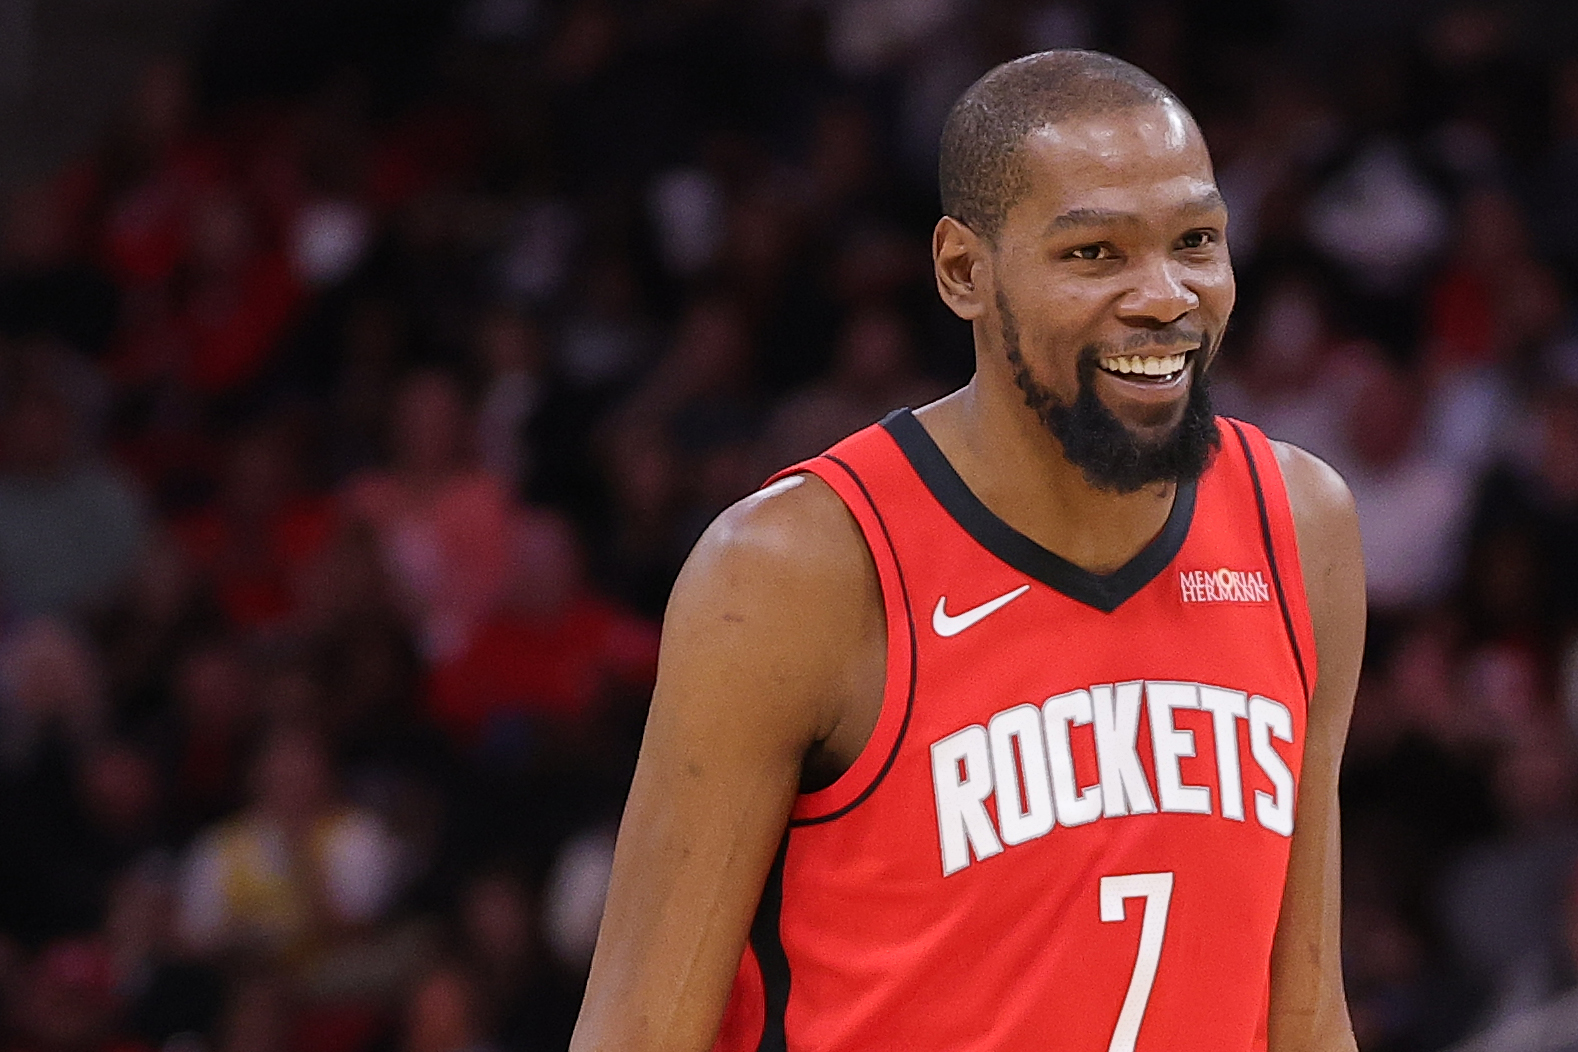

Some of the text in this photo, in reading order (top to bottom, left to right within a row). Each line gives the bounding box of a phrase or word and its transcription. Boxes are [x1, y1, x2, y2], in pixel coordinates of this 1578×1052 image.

[1180, 568, 1268, 588] MEMORIAL
[1182, 586, 1270, 602] HERMANN
[930, 680, 1295, 878] ROCKETS
